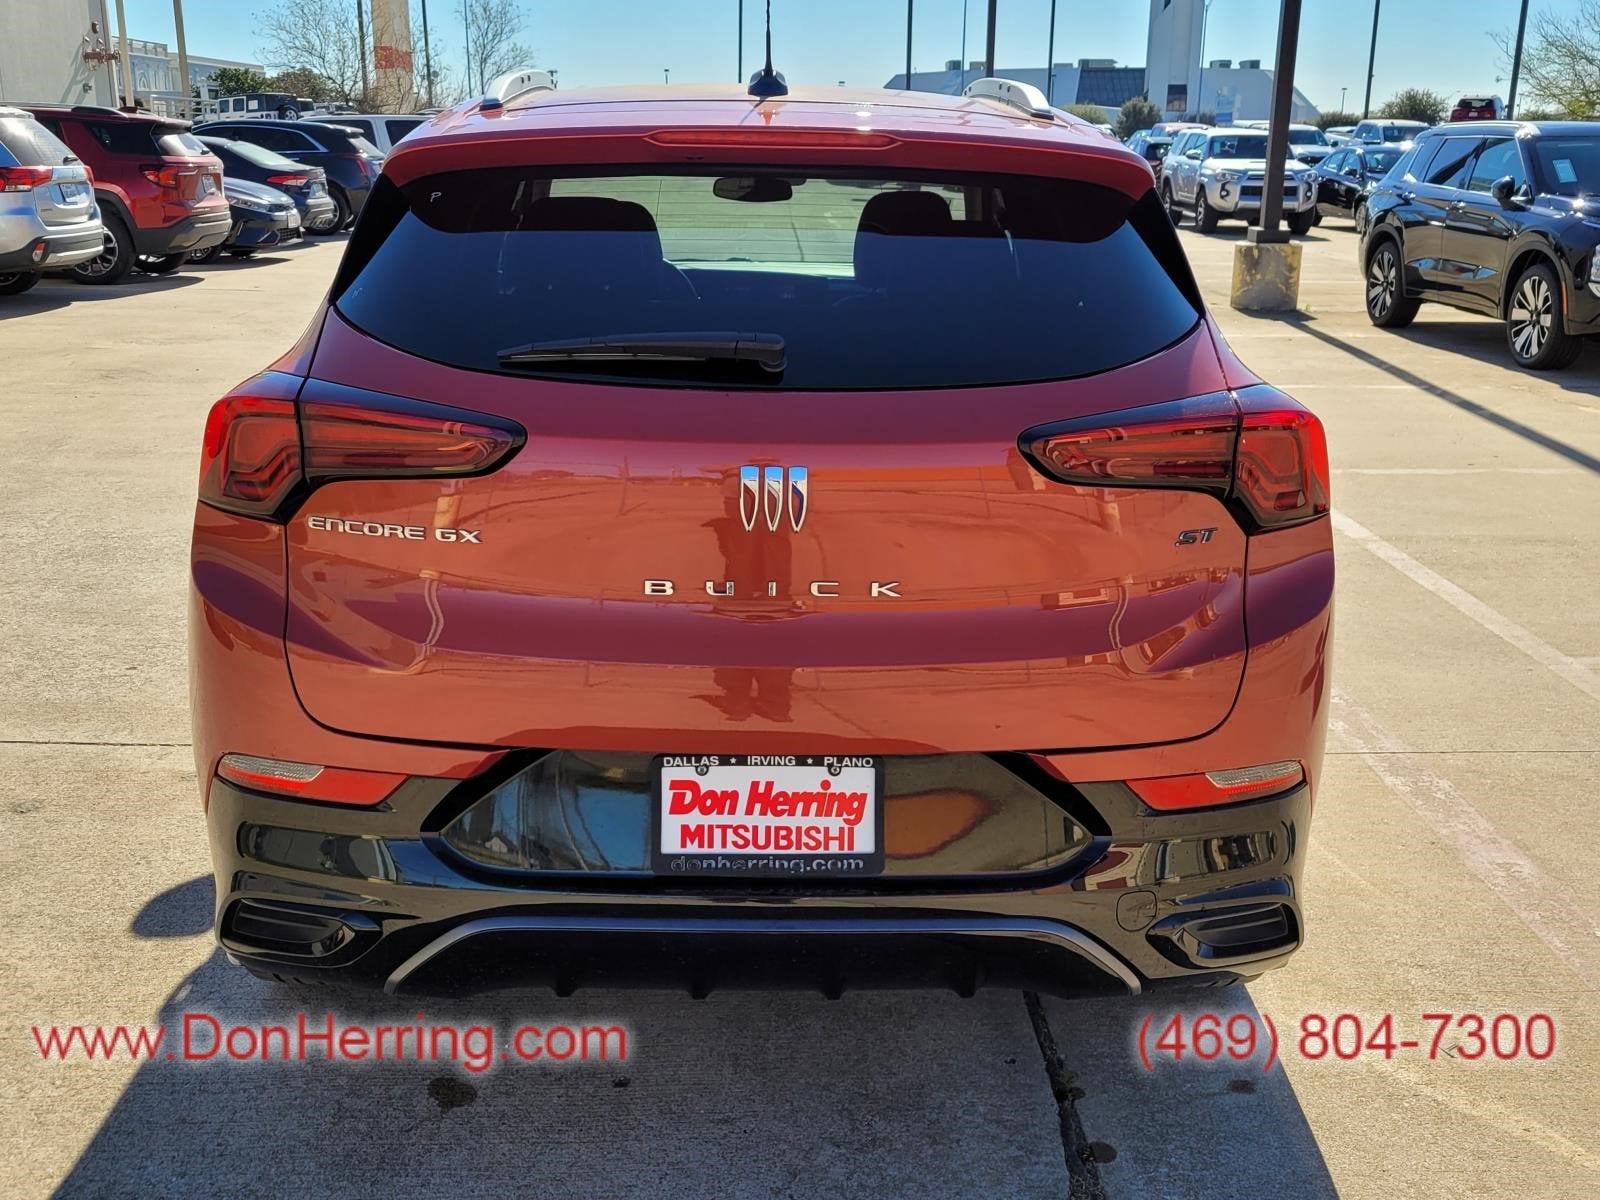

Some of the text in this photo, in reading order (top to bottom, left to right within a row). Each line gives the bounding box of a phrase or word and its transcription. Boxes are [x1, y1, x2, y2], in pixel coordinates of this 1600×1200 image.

[307, 516, 482, 544] ENCORE GX
[1175, 527, 1218, 547] ST
[644, 580, 901, 597] BUICK
[663, 755, 873, 768] DALLAS IRVING PLANO
[668, 779, 868, 826] Don Herring
[680, 823, 855, 852] MITSUBISHI
[670, 856, 864, 874] donherring.com
